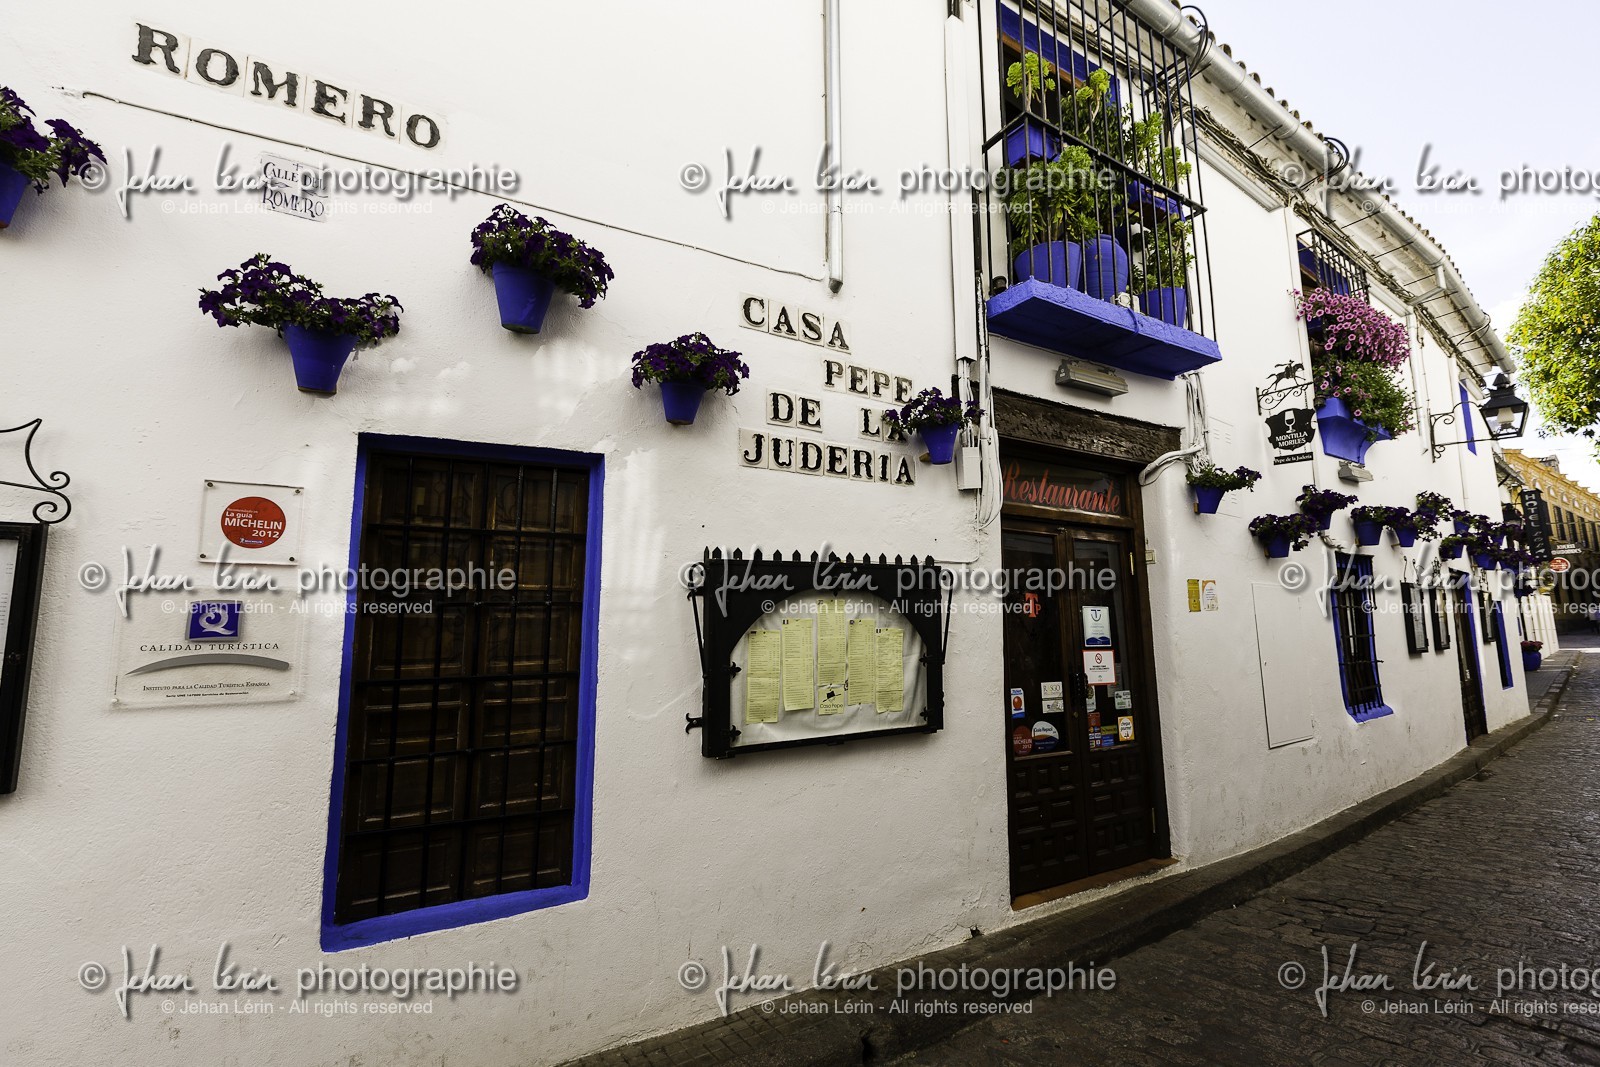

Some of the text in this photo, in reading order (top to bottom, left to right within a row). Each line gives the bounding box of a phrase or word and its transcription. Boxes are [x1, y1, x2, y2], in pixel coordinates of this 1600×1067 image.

[132, 22, 441, 149] ROMERO
[743, 297, 849, 350] CASA
[824, 359, 913, 403] PEPE
[769, 392, 821, 426] DE
[1275, 431, 1308, 442] MONTILLA
[1278, 438, 1306, 447] MORILES
[743, 433, 914, 485] JUDERIA
[1001, 461, 1120, 514] Restaurante
[224, 517, 283, 530] MICHELIN
[1524, 493, 1540, 528] HOTEL
[252, 529, 279, 539] 2012
[140, 641, 280, 652] CALIDAD TURÍSTICA
